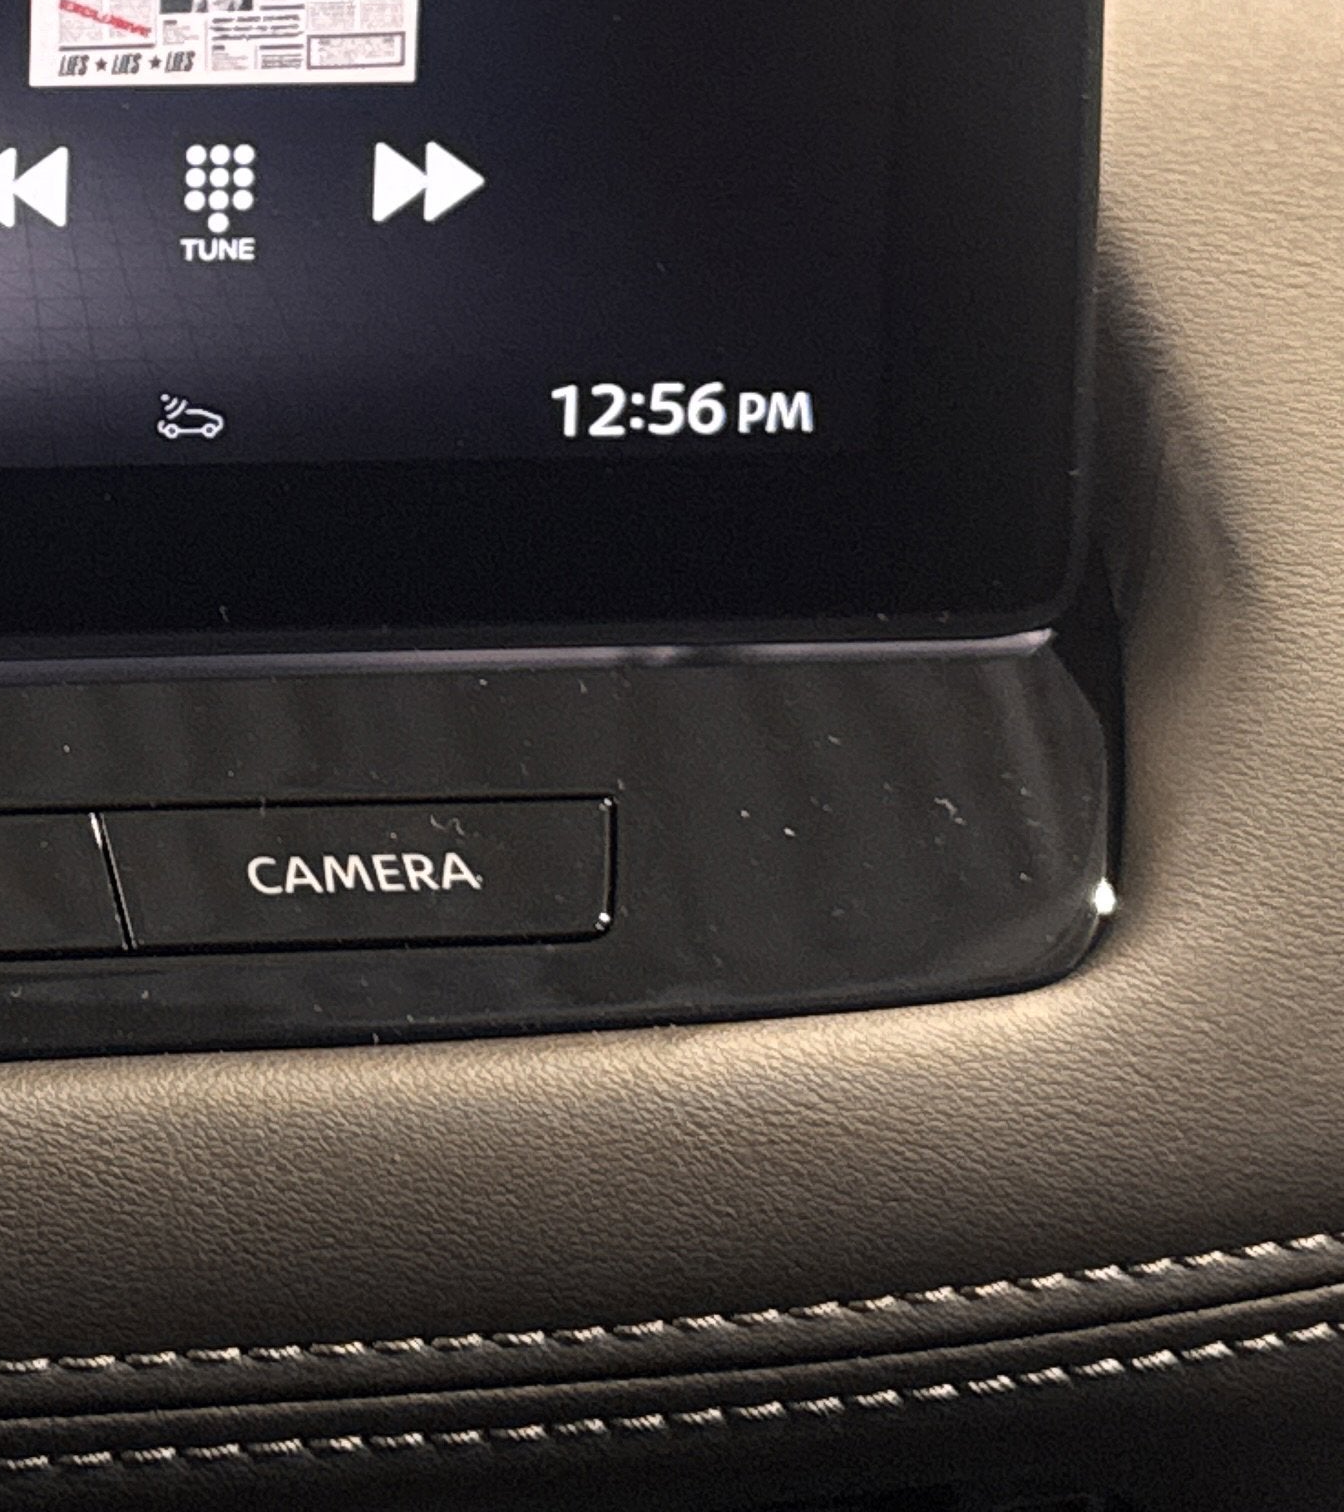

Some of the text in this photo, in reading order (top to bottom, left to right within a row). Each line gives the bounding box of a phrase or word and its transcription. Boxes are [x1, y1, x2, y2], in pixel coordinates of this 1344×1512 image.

[180, 238, 254, 261] TUNE
[552, 382, 813, 437] 12:56 PM
[247, 852, 476, 895] CAMERA
